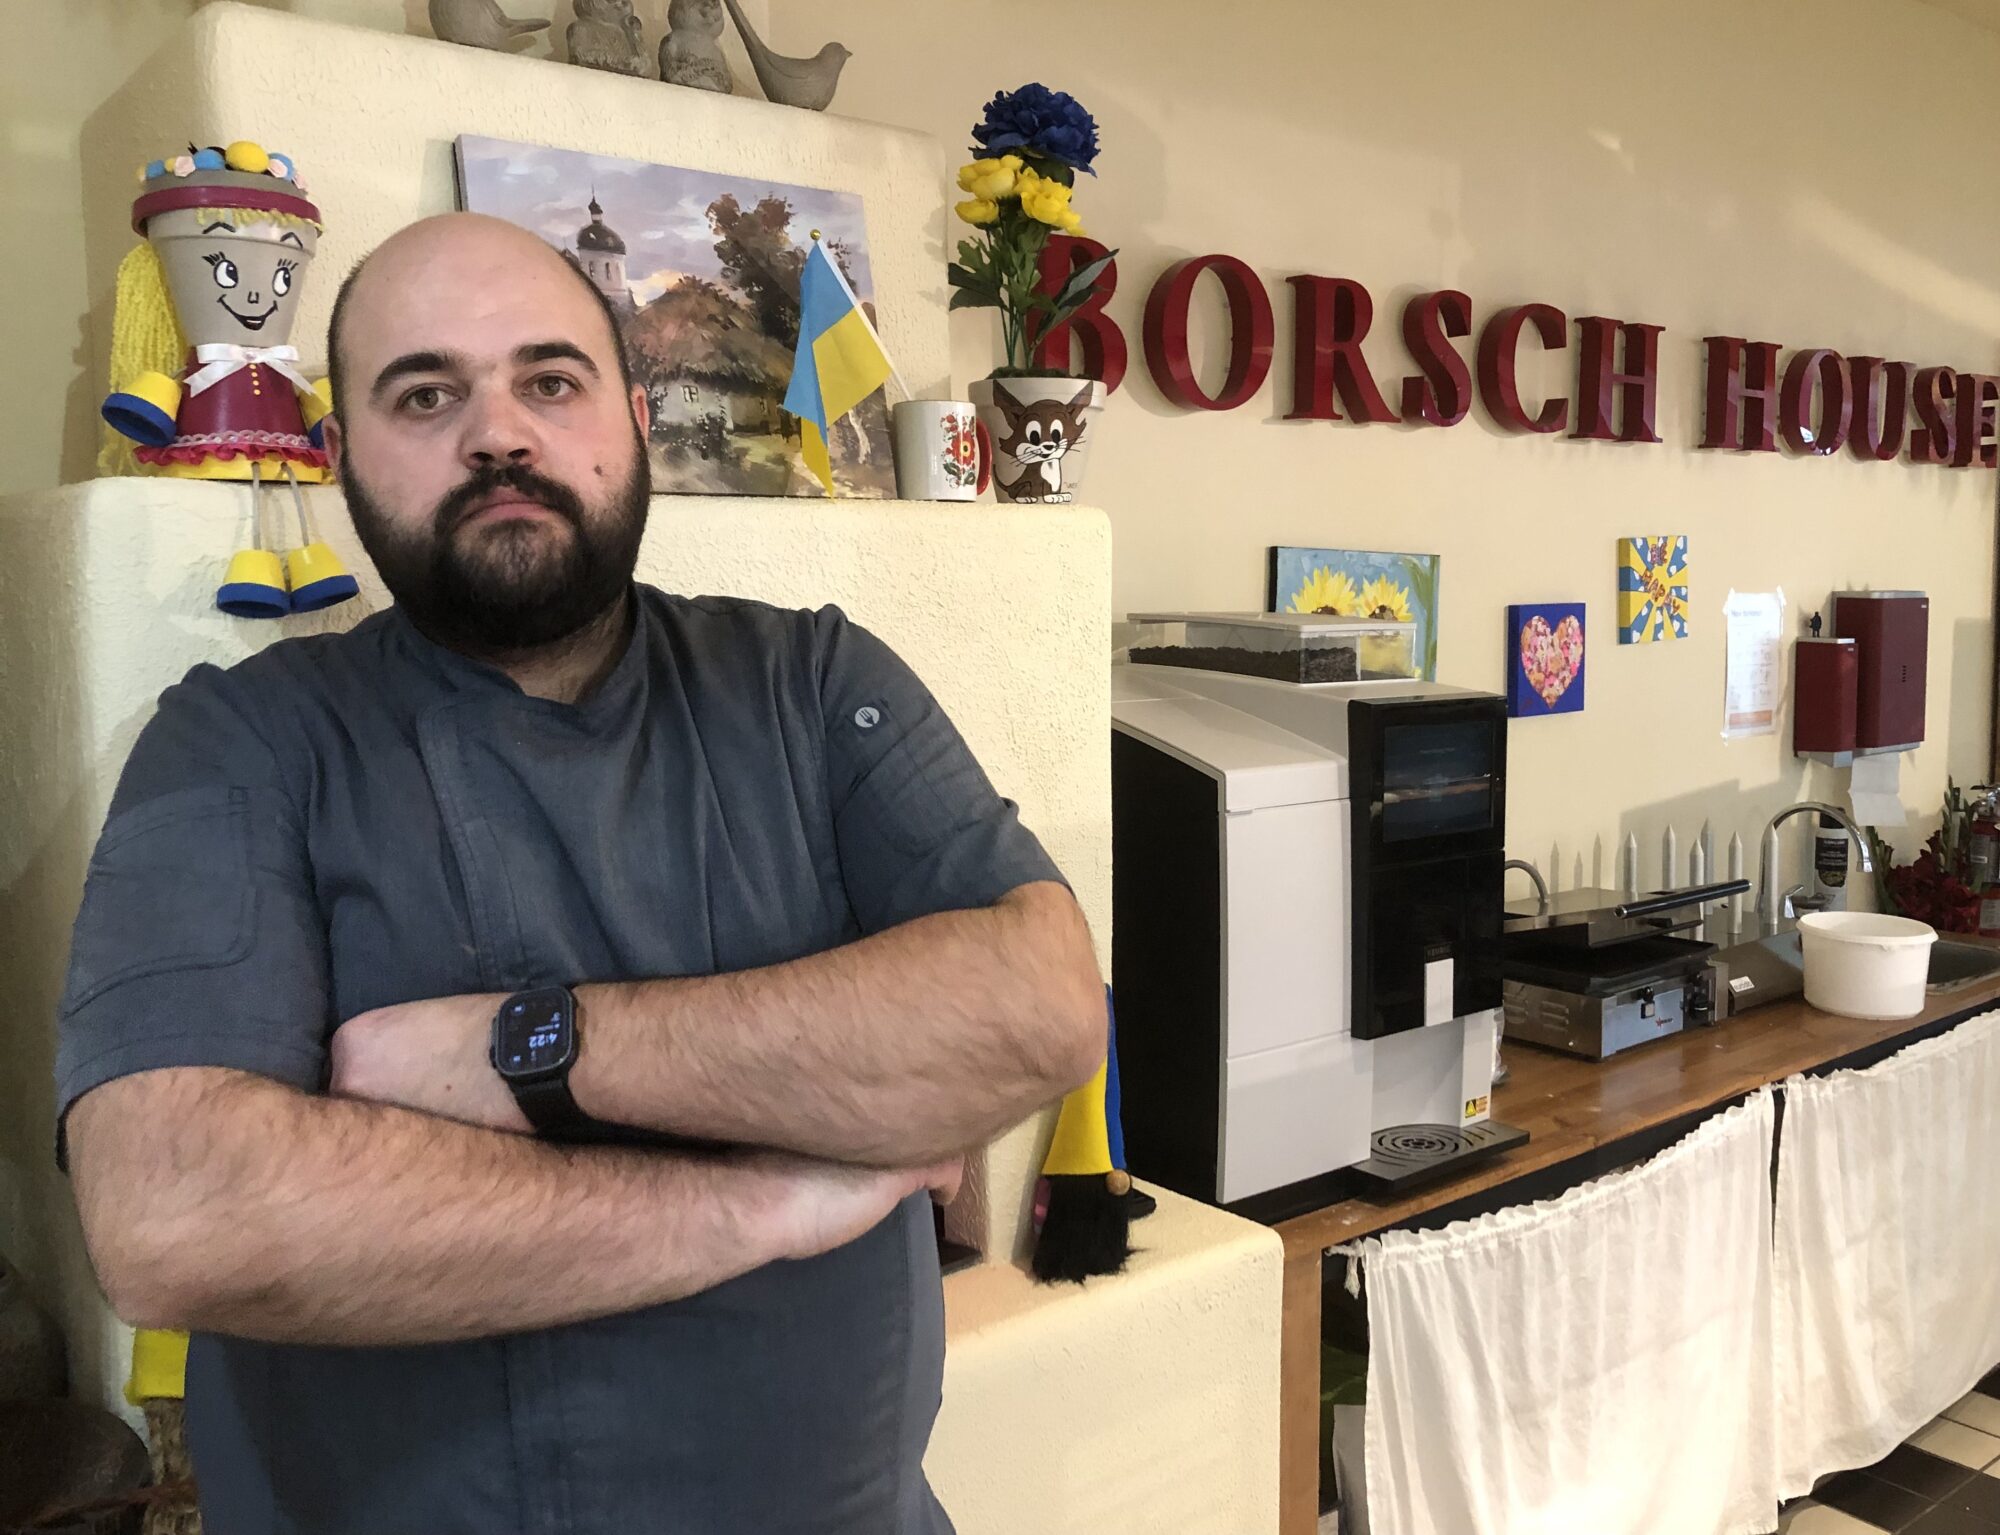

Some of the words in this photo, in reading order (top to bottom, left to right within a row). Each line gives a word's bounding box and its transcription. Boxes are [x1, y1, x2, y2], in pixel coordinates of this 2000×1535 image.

[1026, 233, 1665, 444] BORSCH
[1697, 335, 2000, 468] HOUSE
[529, 1033, 557, 1048] 4:22
